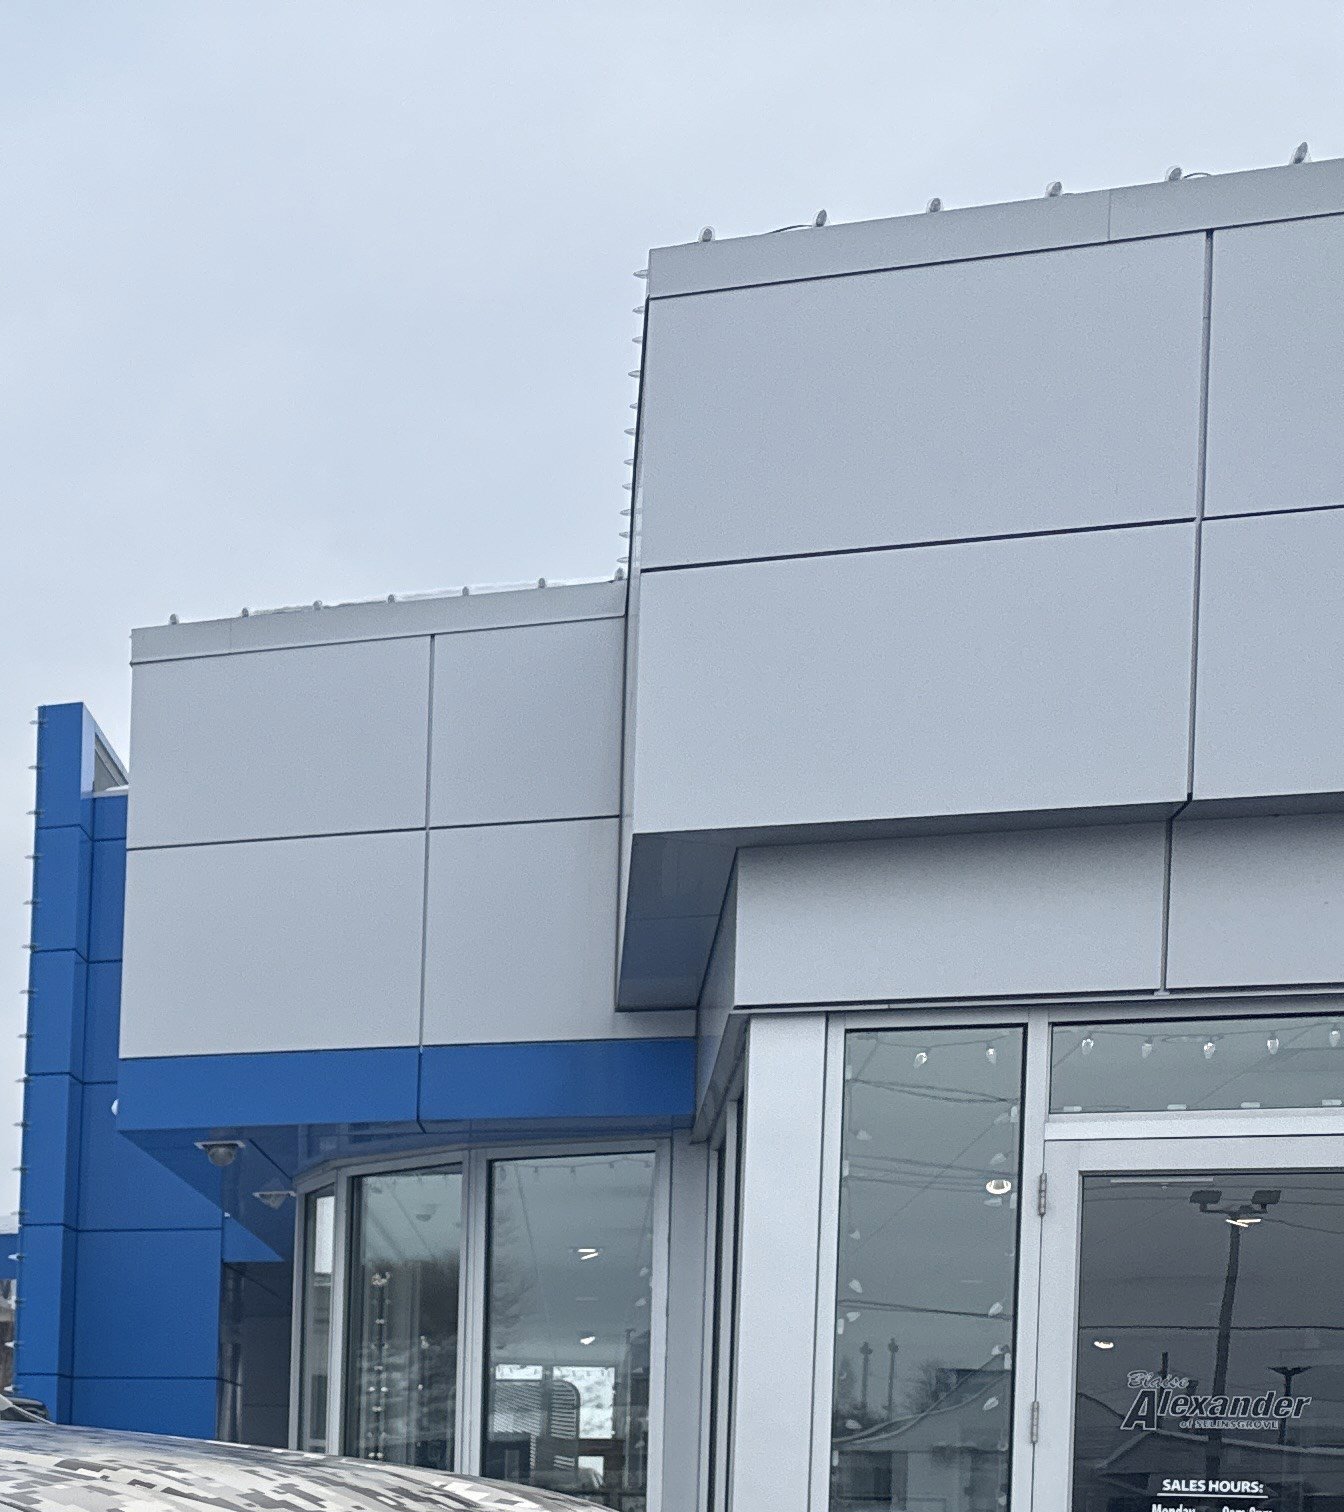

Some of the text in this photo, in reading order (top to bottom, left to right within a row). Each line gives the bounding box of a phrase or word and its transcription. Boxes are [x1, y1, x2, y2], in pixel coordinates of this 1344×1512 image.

[1126, 1369, 1190, 1389] Blaise
[1120, 1388, 1312, 1431] Alexander
[1179, 1418, 1193, 1430] of
[1162, 1479, 1264, 1494] SALES HOURS:
